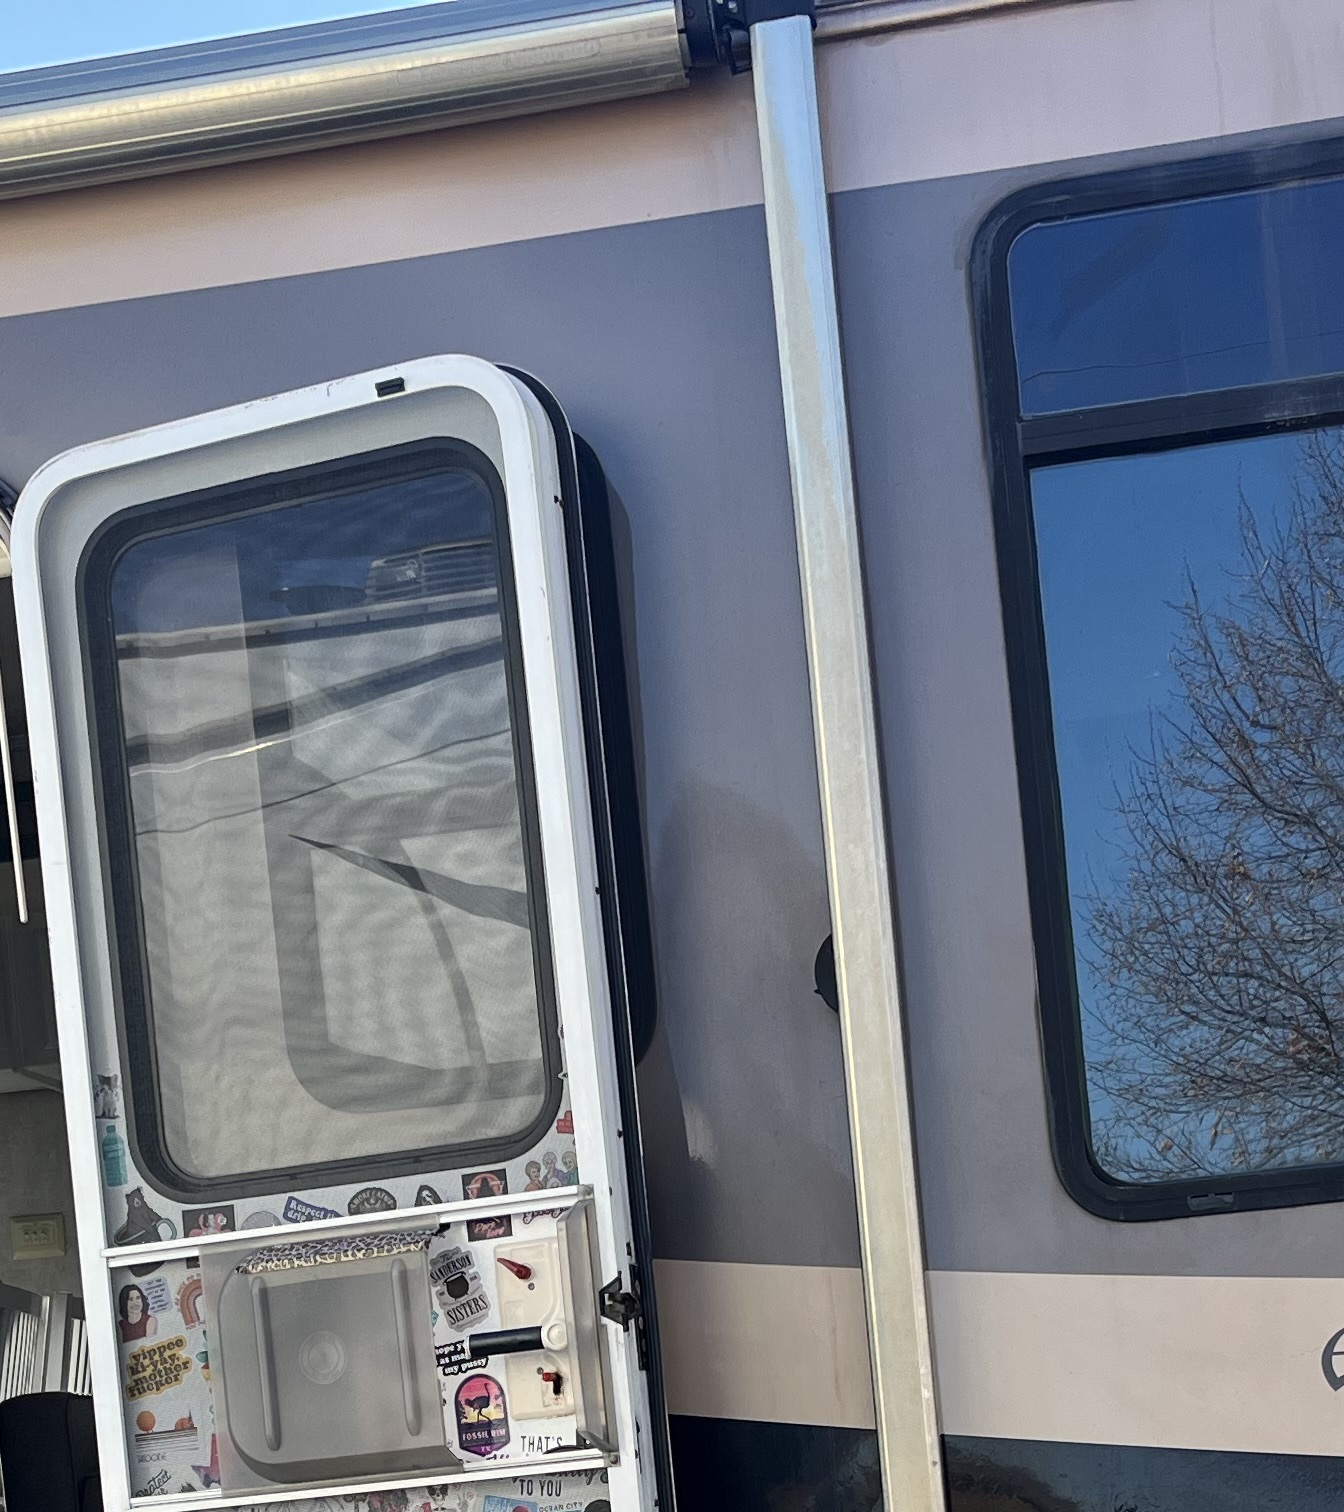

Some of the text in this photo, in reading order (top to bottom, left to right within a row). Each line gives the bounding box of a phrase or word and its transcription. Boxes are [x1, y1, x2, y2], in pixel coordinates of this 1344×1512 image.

[430, 1254, 472, 1284] SANDERSON
[446, 1294, 488, 1326] SISTERS
[133, 1359, 190, 1387] mother
[461, 1357, 488, 1372] pussy
[462, 1430, 489, 1442] FOSSIL
[520, 1435, 563, 1453] THAT'S
[520, 1479, 562, 1497] TO YOU
[566, 1501, 583, 1510] CITY
